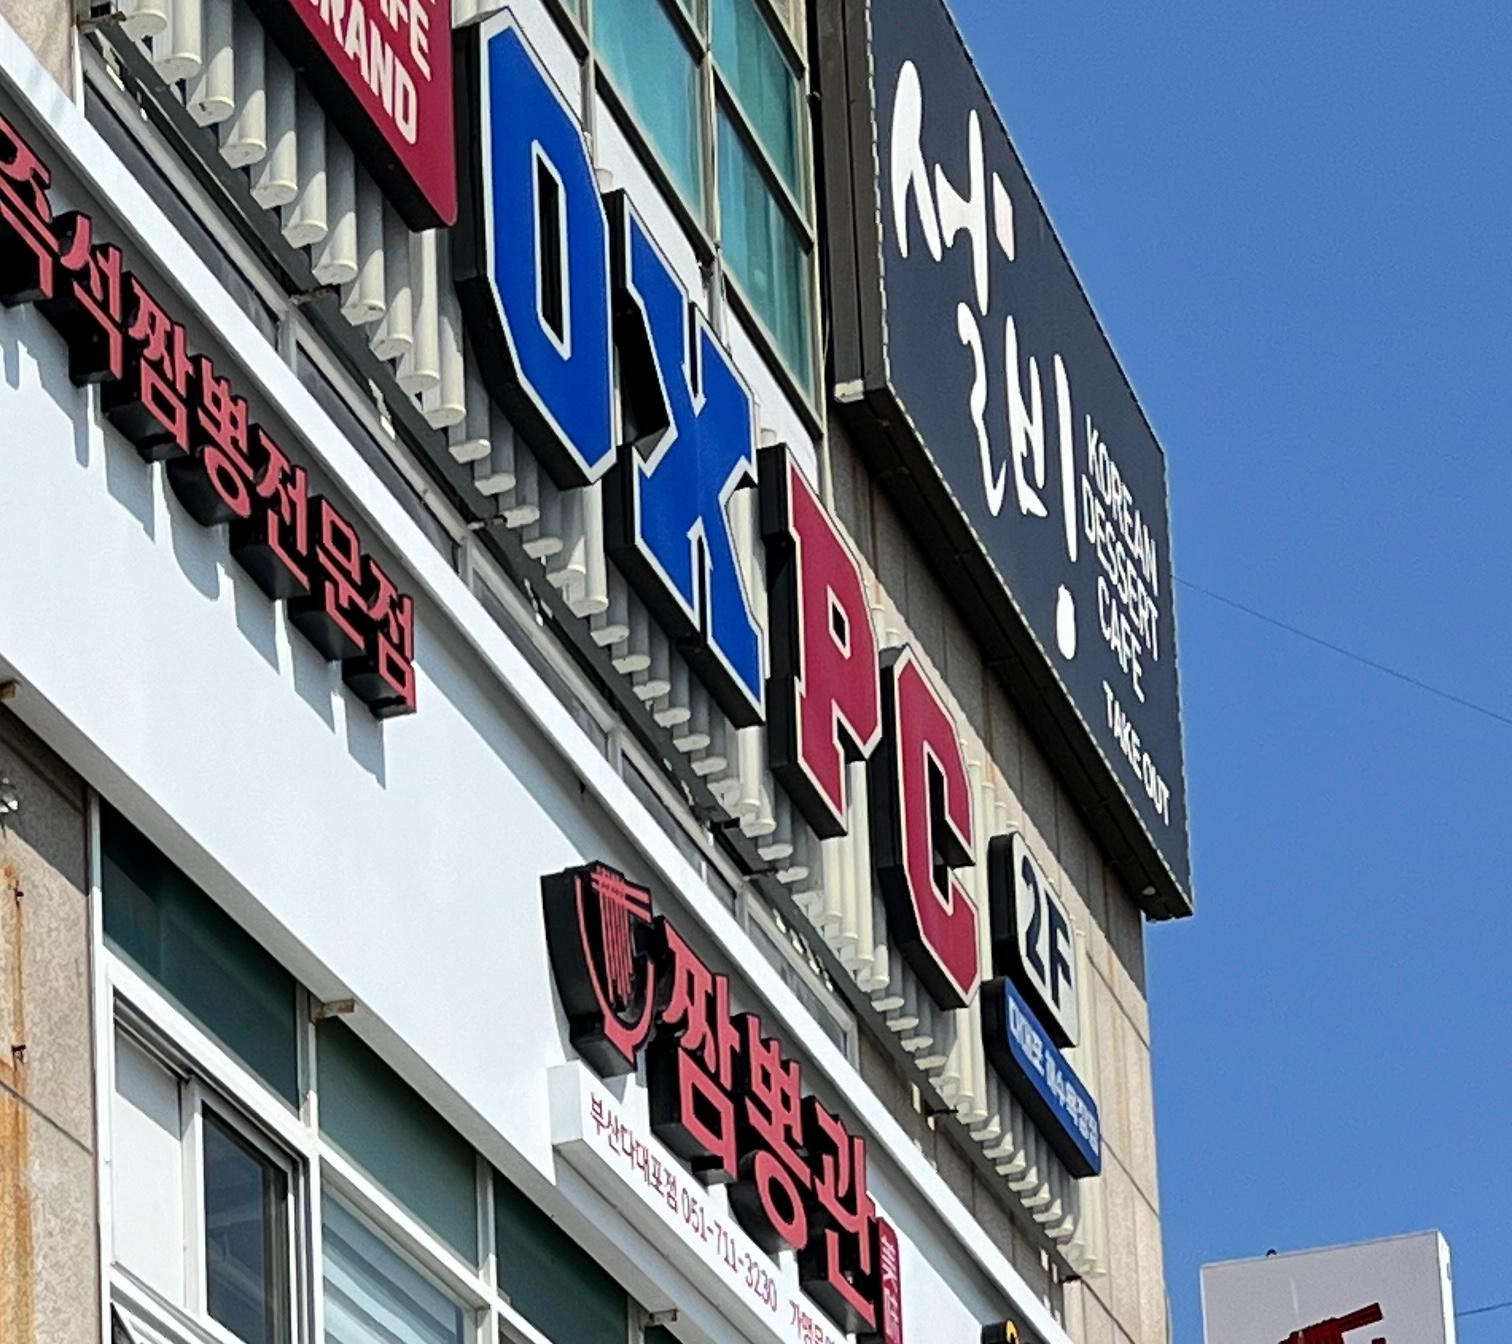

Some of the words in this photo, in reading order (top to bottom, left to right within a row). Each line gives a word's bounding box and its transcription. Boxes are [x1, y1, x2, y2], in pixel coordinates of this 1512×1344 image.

[891, 60, 1078, 660] 설빙
[1081, 473, 1159, 662] DESSERT
[1085, 414, 1159, 596] KOREAN
[1097, 575, 1145, 702] CAFE
[1102, 679, 1142, 779] TAKE
[1141, 752, 1170, 826] OUT
[1021, 855, 1073, 1014] 2F
[590, 1091, 678, 1216] 부산다대포점
[681, 1184, 778, 1313] 051-711-3230
[662, 921, 877, 1331] 짬뽕관
